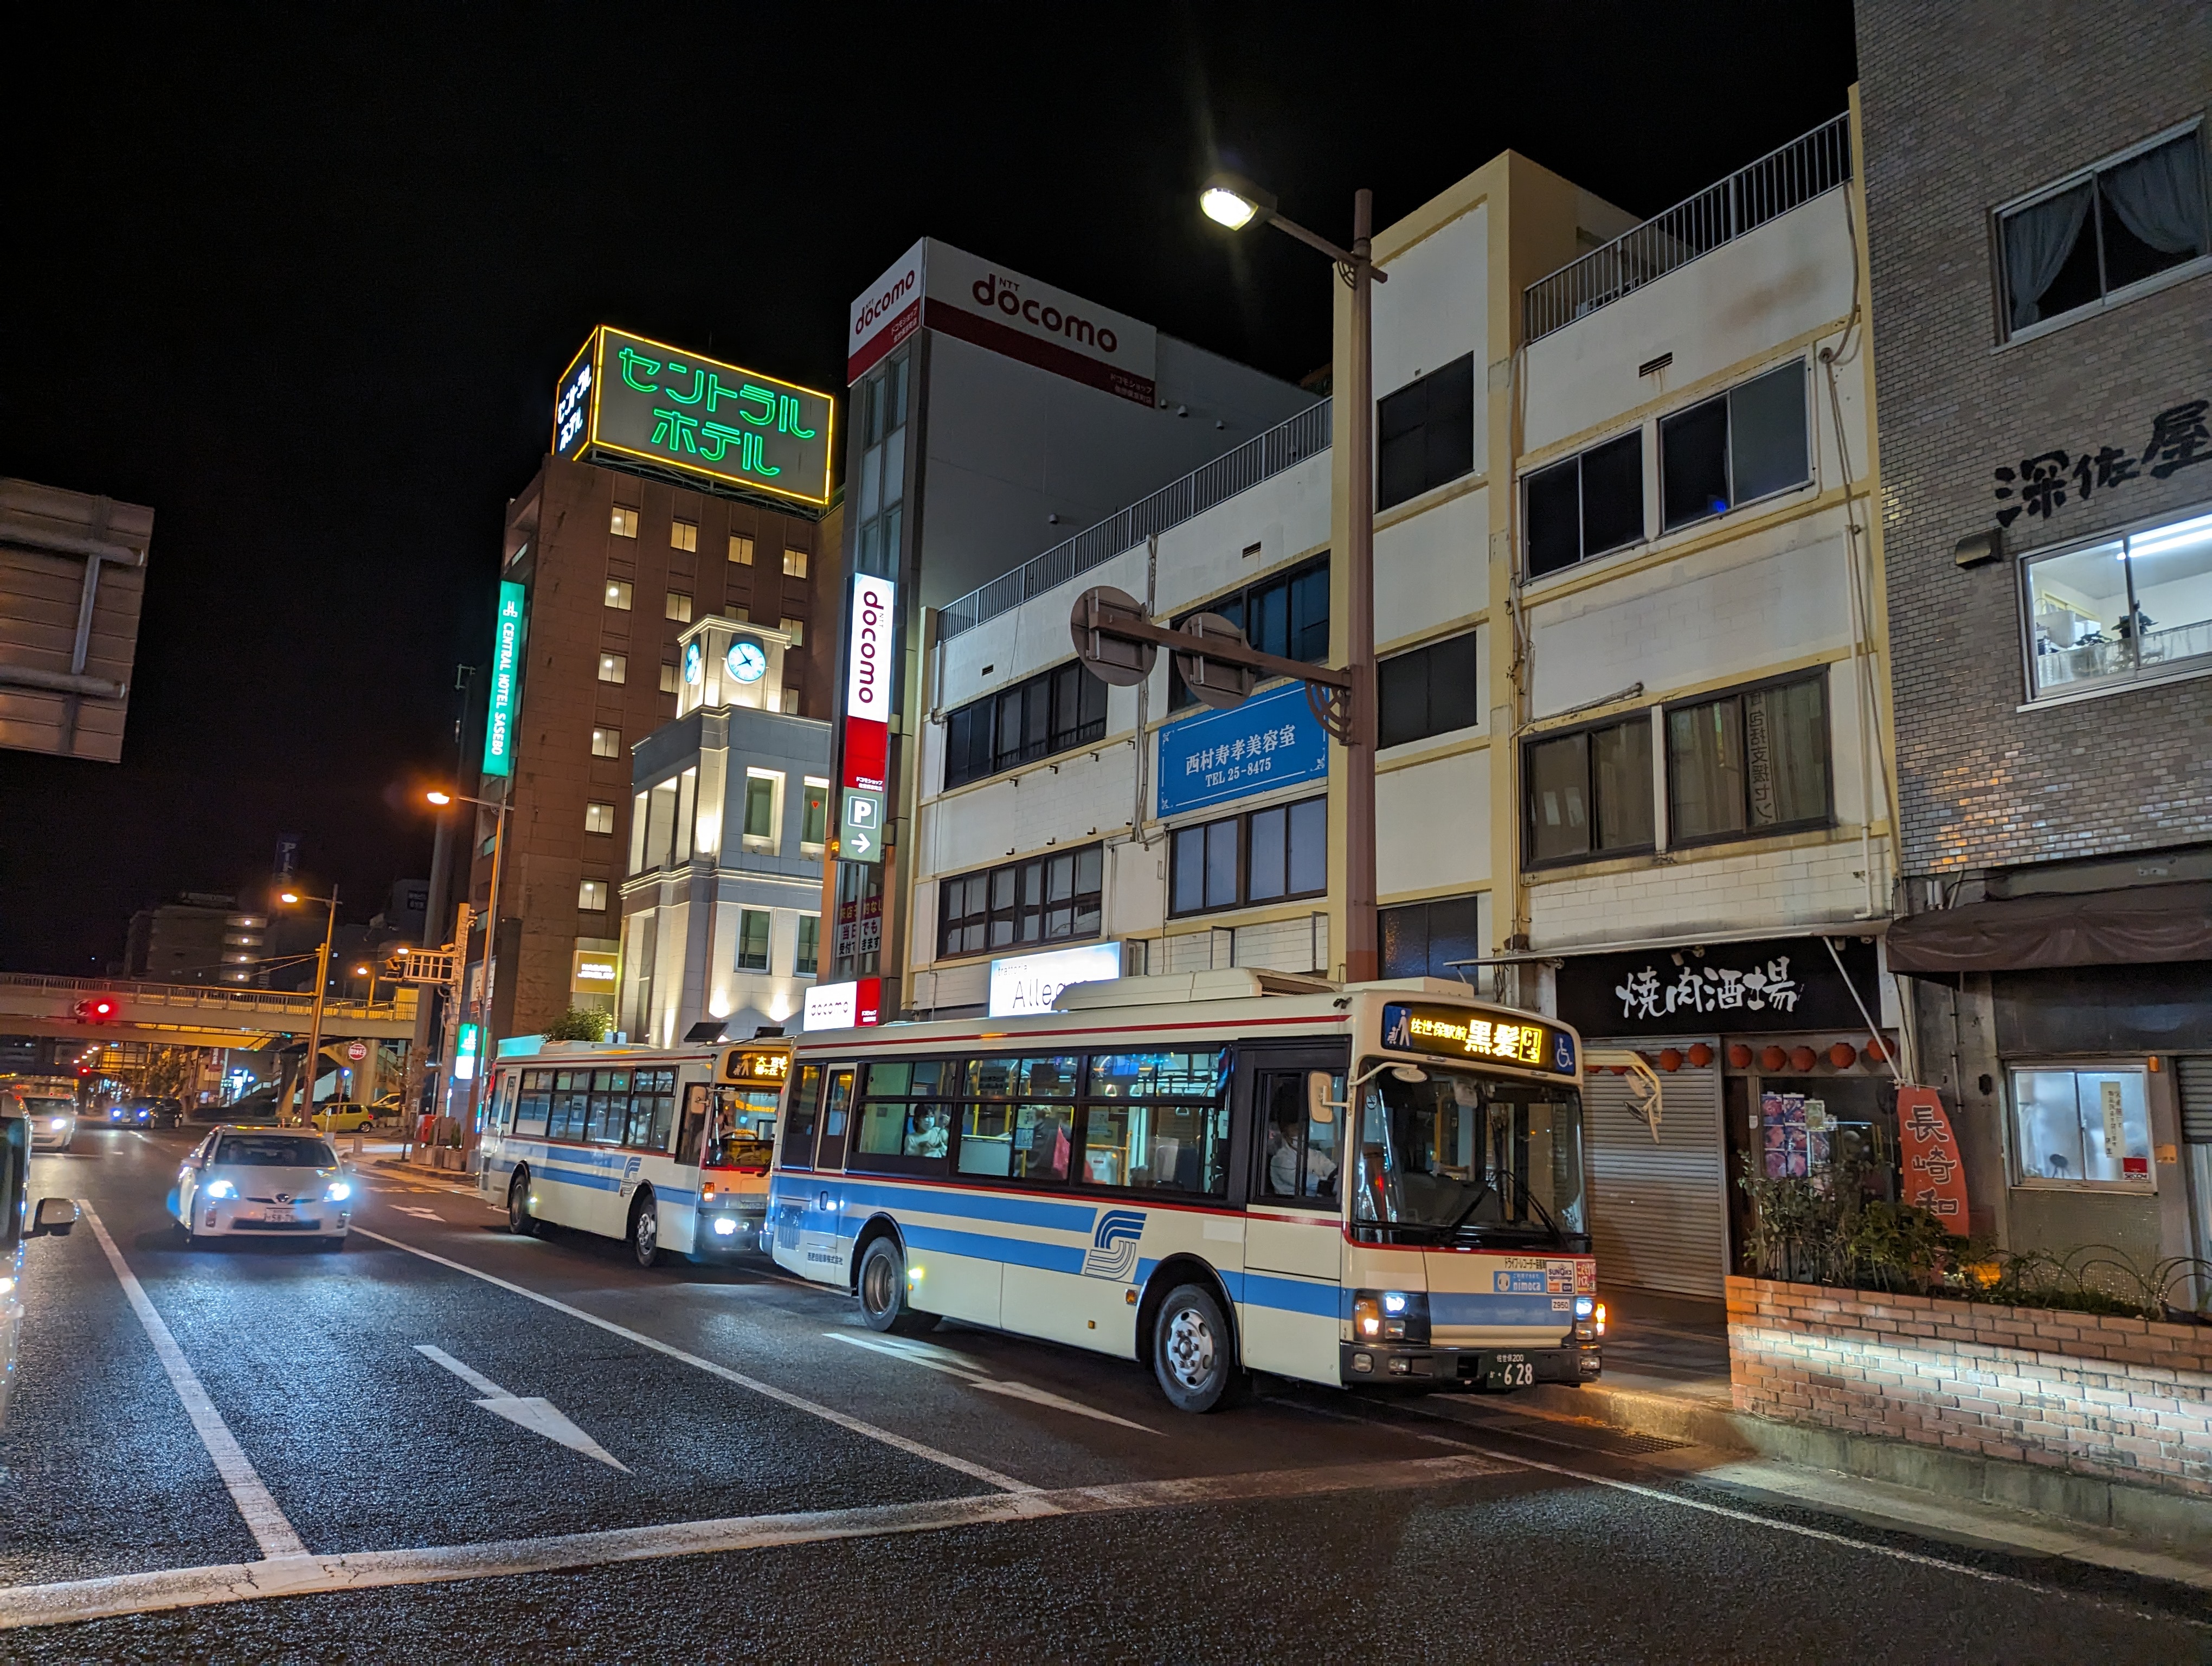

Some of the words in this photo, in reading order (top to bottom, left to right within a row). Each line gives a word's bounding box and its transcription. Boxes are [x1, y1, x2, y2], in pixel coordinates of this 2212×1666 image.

[855, 269, 915, 335] docomo
[999, 277, 1020, 291] NTT
[972, 273, 1118, 353] docomo
[557, 364, 592, 424] セントラル
[618, 346, 816, 439] セントラル
[559, 406, 583, 451] ホテル
[651, 406, 781, 477] ホテル
[500, 622, 515, 670] CENTRAL
[858, 591, 884, 703] docomo
[496, 674, 510, 709] HOTEL
[491, 712, 506, 755] SASEBO
[1185, 723, 1296, 776] 西村寿孝美容室
[1205, 771, 1225, 788] TEL
[1227, 758, 1271, 782] 25-8475
[854, 800, 871, 823] P
[998, 963, 1028, 976] trattoria
[1616, 956, 1798, 1019] 焼肉酒場
[1410, 1018, 1468, 1041] 佐世保駅前
[1464, 1020, 1520, 1058] 黒髪
[1513, 1279, 1541, 1291] nimoca
[1553, 1301, 1569, 1309] Z950
